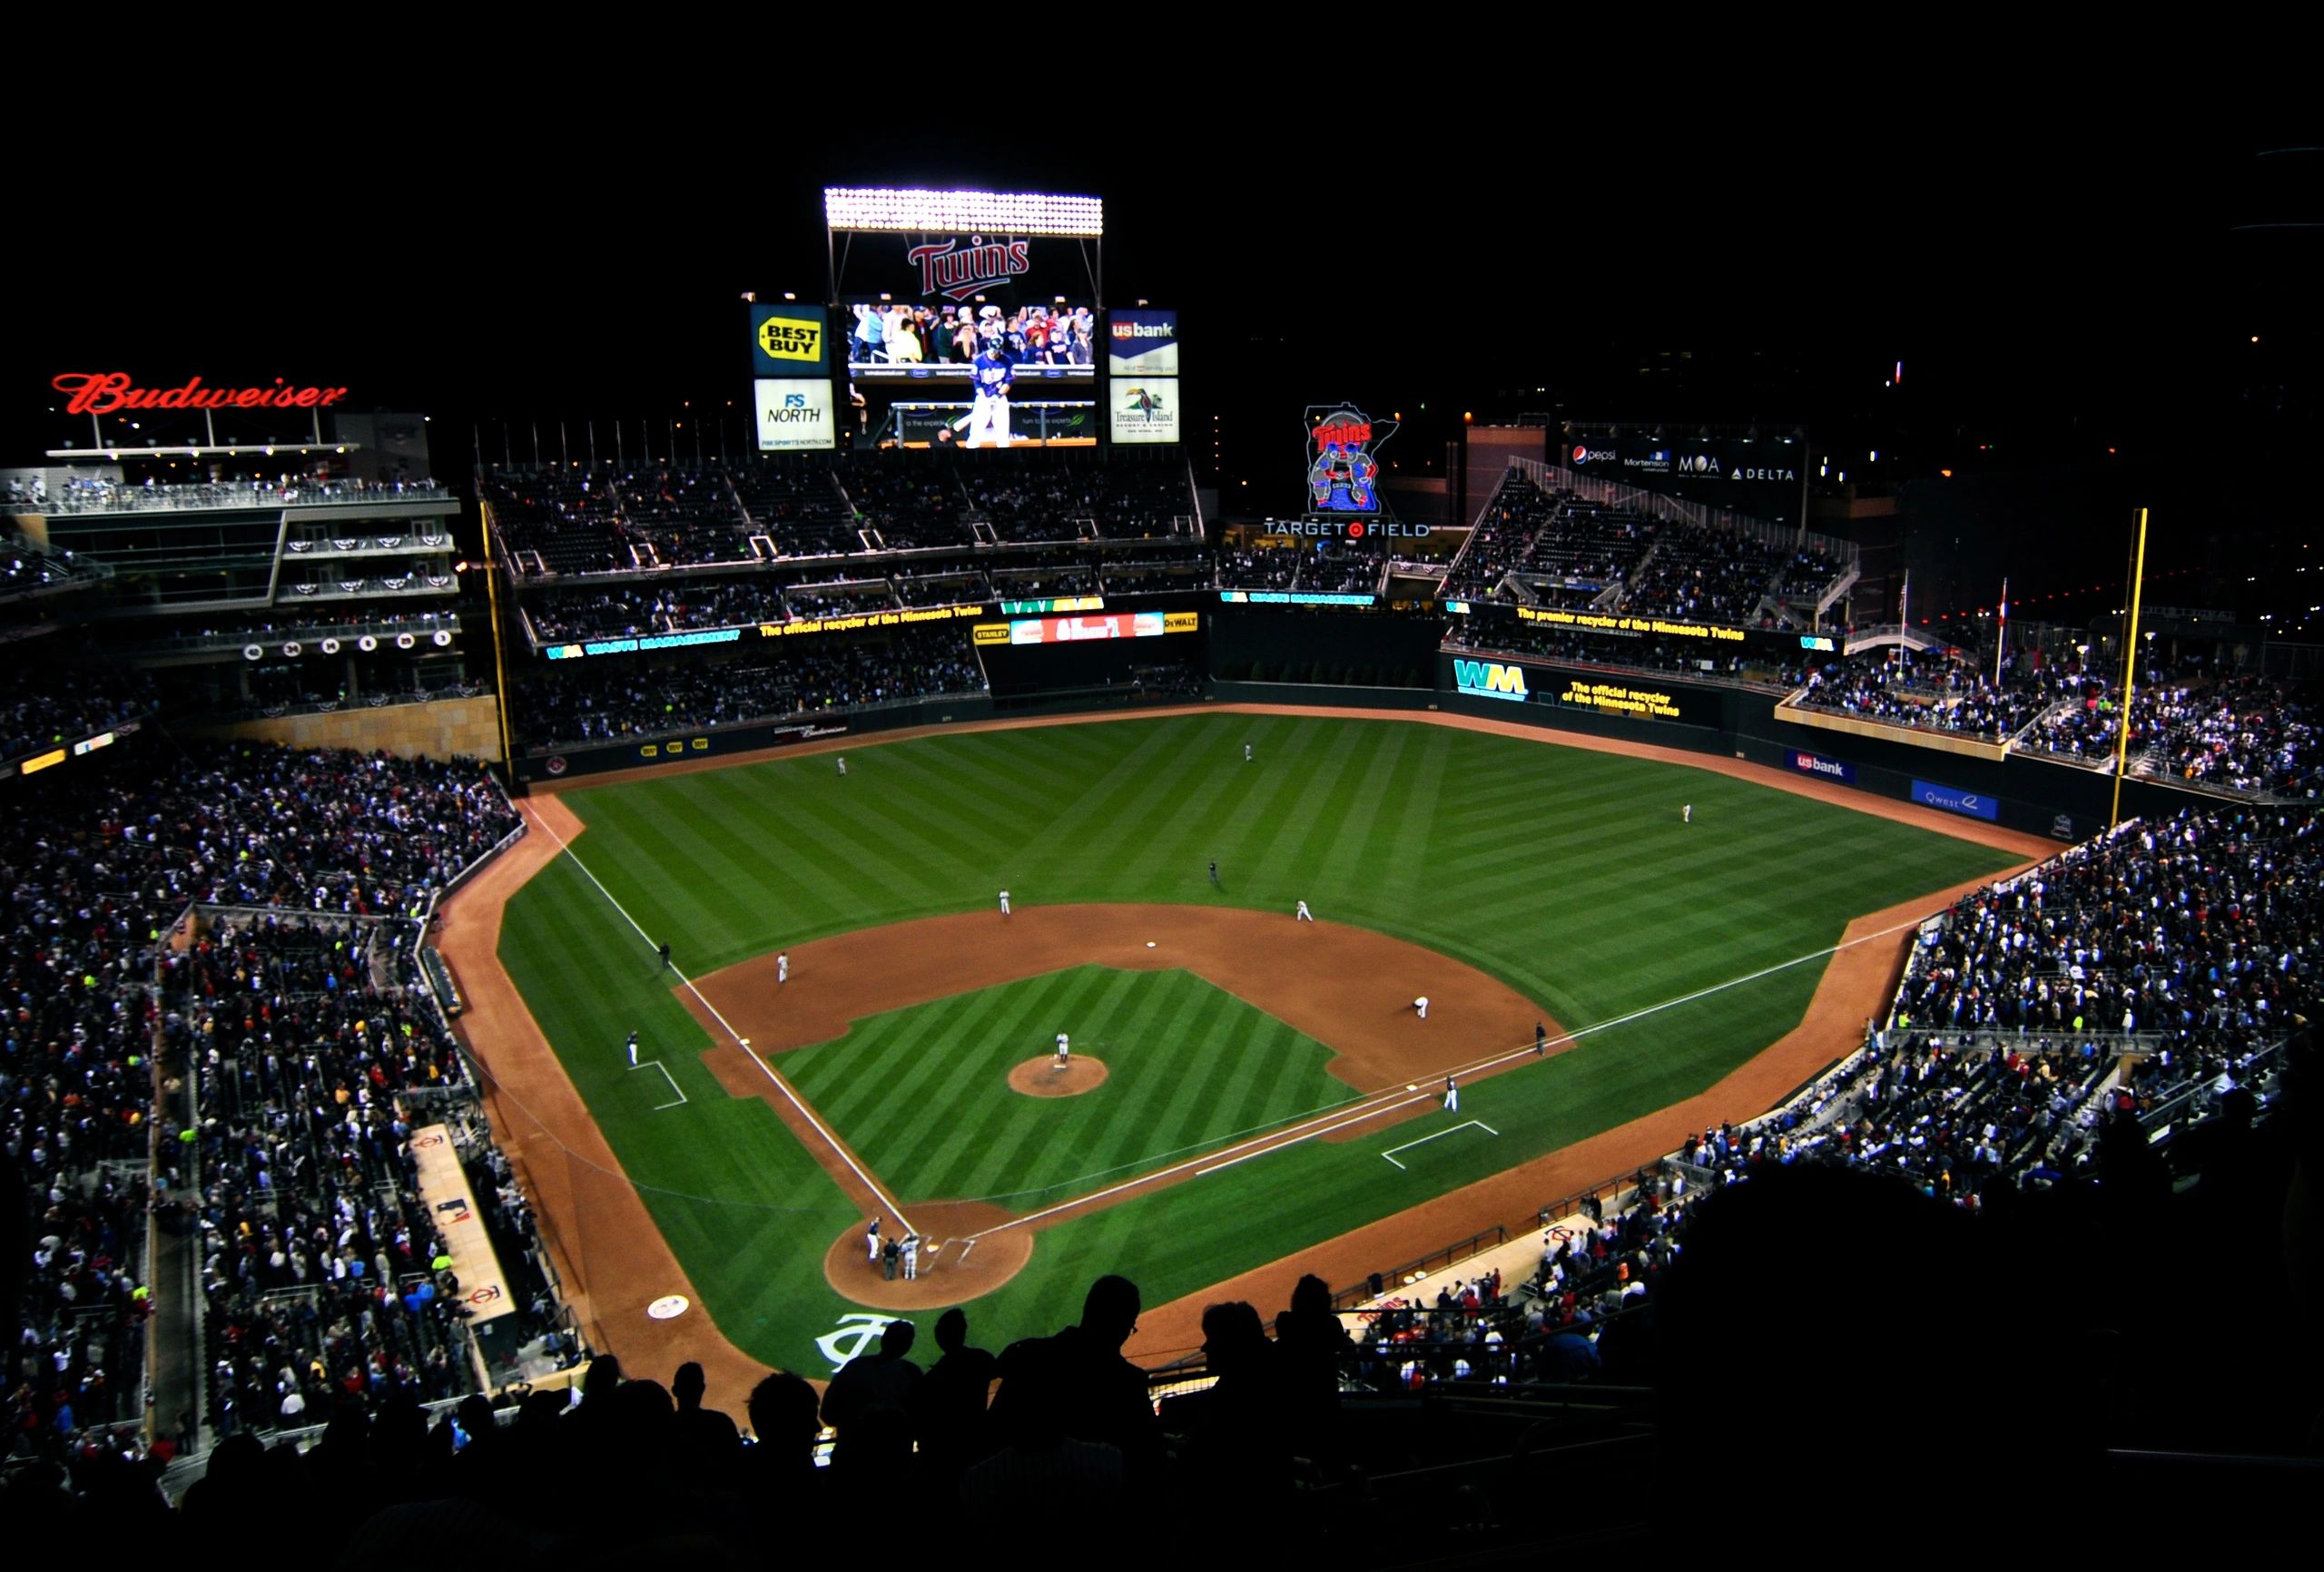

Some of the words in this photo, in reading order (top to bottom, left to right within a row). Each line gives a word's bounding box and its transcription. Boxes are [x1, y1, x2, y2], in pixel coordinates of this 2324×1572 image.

[908, 236, 1029, 296] Twins
[767, 325, 818, 342] BEST
[1112, 322, 1173, 338] usbank
[769, 339, 813, 354] BUY
[51, 372, 348, 415] Budweiser
[784, 393, 805, 408] FS
[767, 408, 821, 423] NORTH
[1115, 410, 1145, 422] Treasure
[1152, 410, 1173, 422] Island
[1312, 422, 1373, 453] Twins
[1588, 450, 1616, 461] pepsi
[1624, 458, 1669, 467] Mortenson
[1747, 468, 1794, 481] DELTA
[1264, 522, 1345, 535] TARGET
[1368, 523, 1430, 537] FIELD
[760, 624, 782, 637] The
[783, 621, 822, 634] official
[823, 616, 866, 632] recycler
[868, 614, 881, 627] of
[881, 614, 899, 625] the
[901, 609, 952, 624] Minnesota
[953, 604, 983, 617] Twins
[1517, 607, 1535, 620] The
[1536, 609, 1575, 625] premier
[1576, 612, 1617, 629] recycler
[1619, 616, 1632, 629] of
[1632, 618, 1650, 633] the
[1651, 620, 1709, 637] Minnesota
[1710, 626, 1745, 641] Twins
[977, 630, 1008, 640] STANLEY
[1453, 659, 1526, 693] WM
[1571, 681, 1590, 693] The
[1591, 683, 1626, 699] official
[1628, 691, 1670, 705] recycler
[1561, 693, 1574, 702] of
[1574, 693, 1592, 704] the
[1593, 695, 1646, 712] Minnesota
[1648, 701, 1679, 717] Twins
[1797, 752, 1844, 777] usbank
[1925, 791, 1959, 808] Qwest
